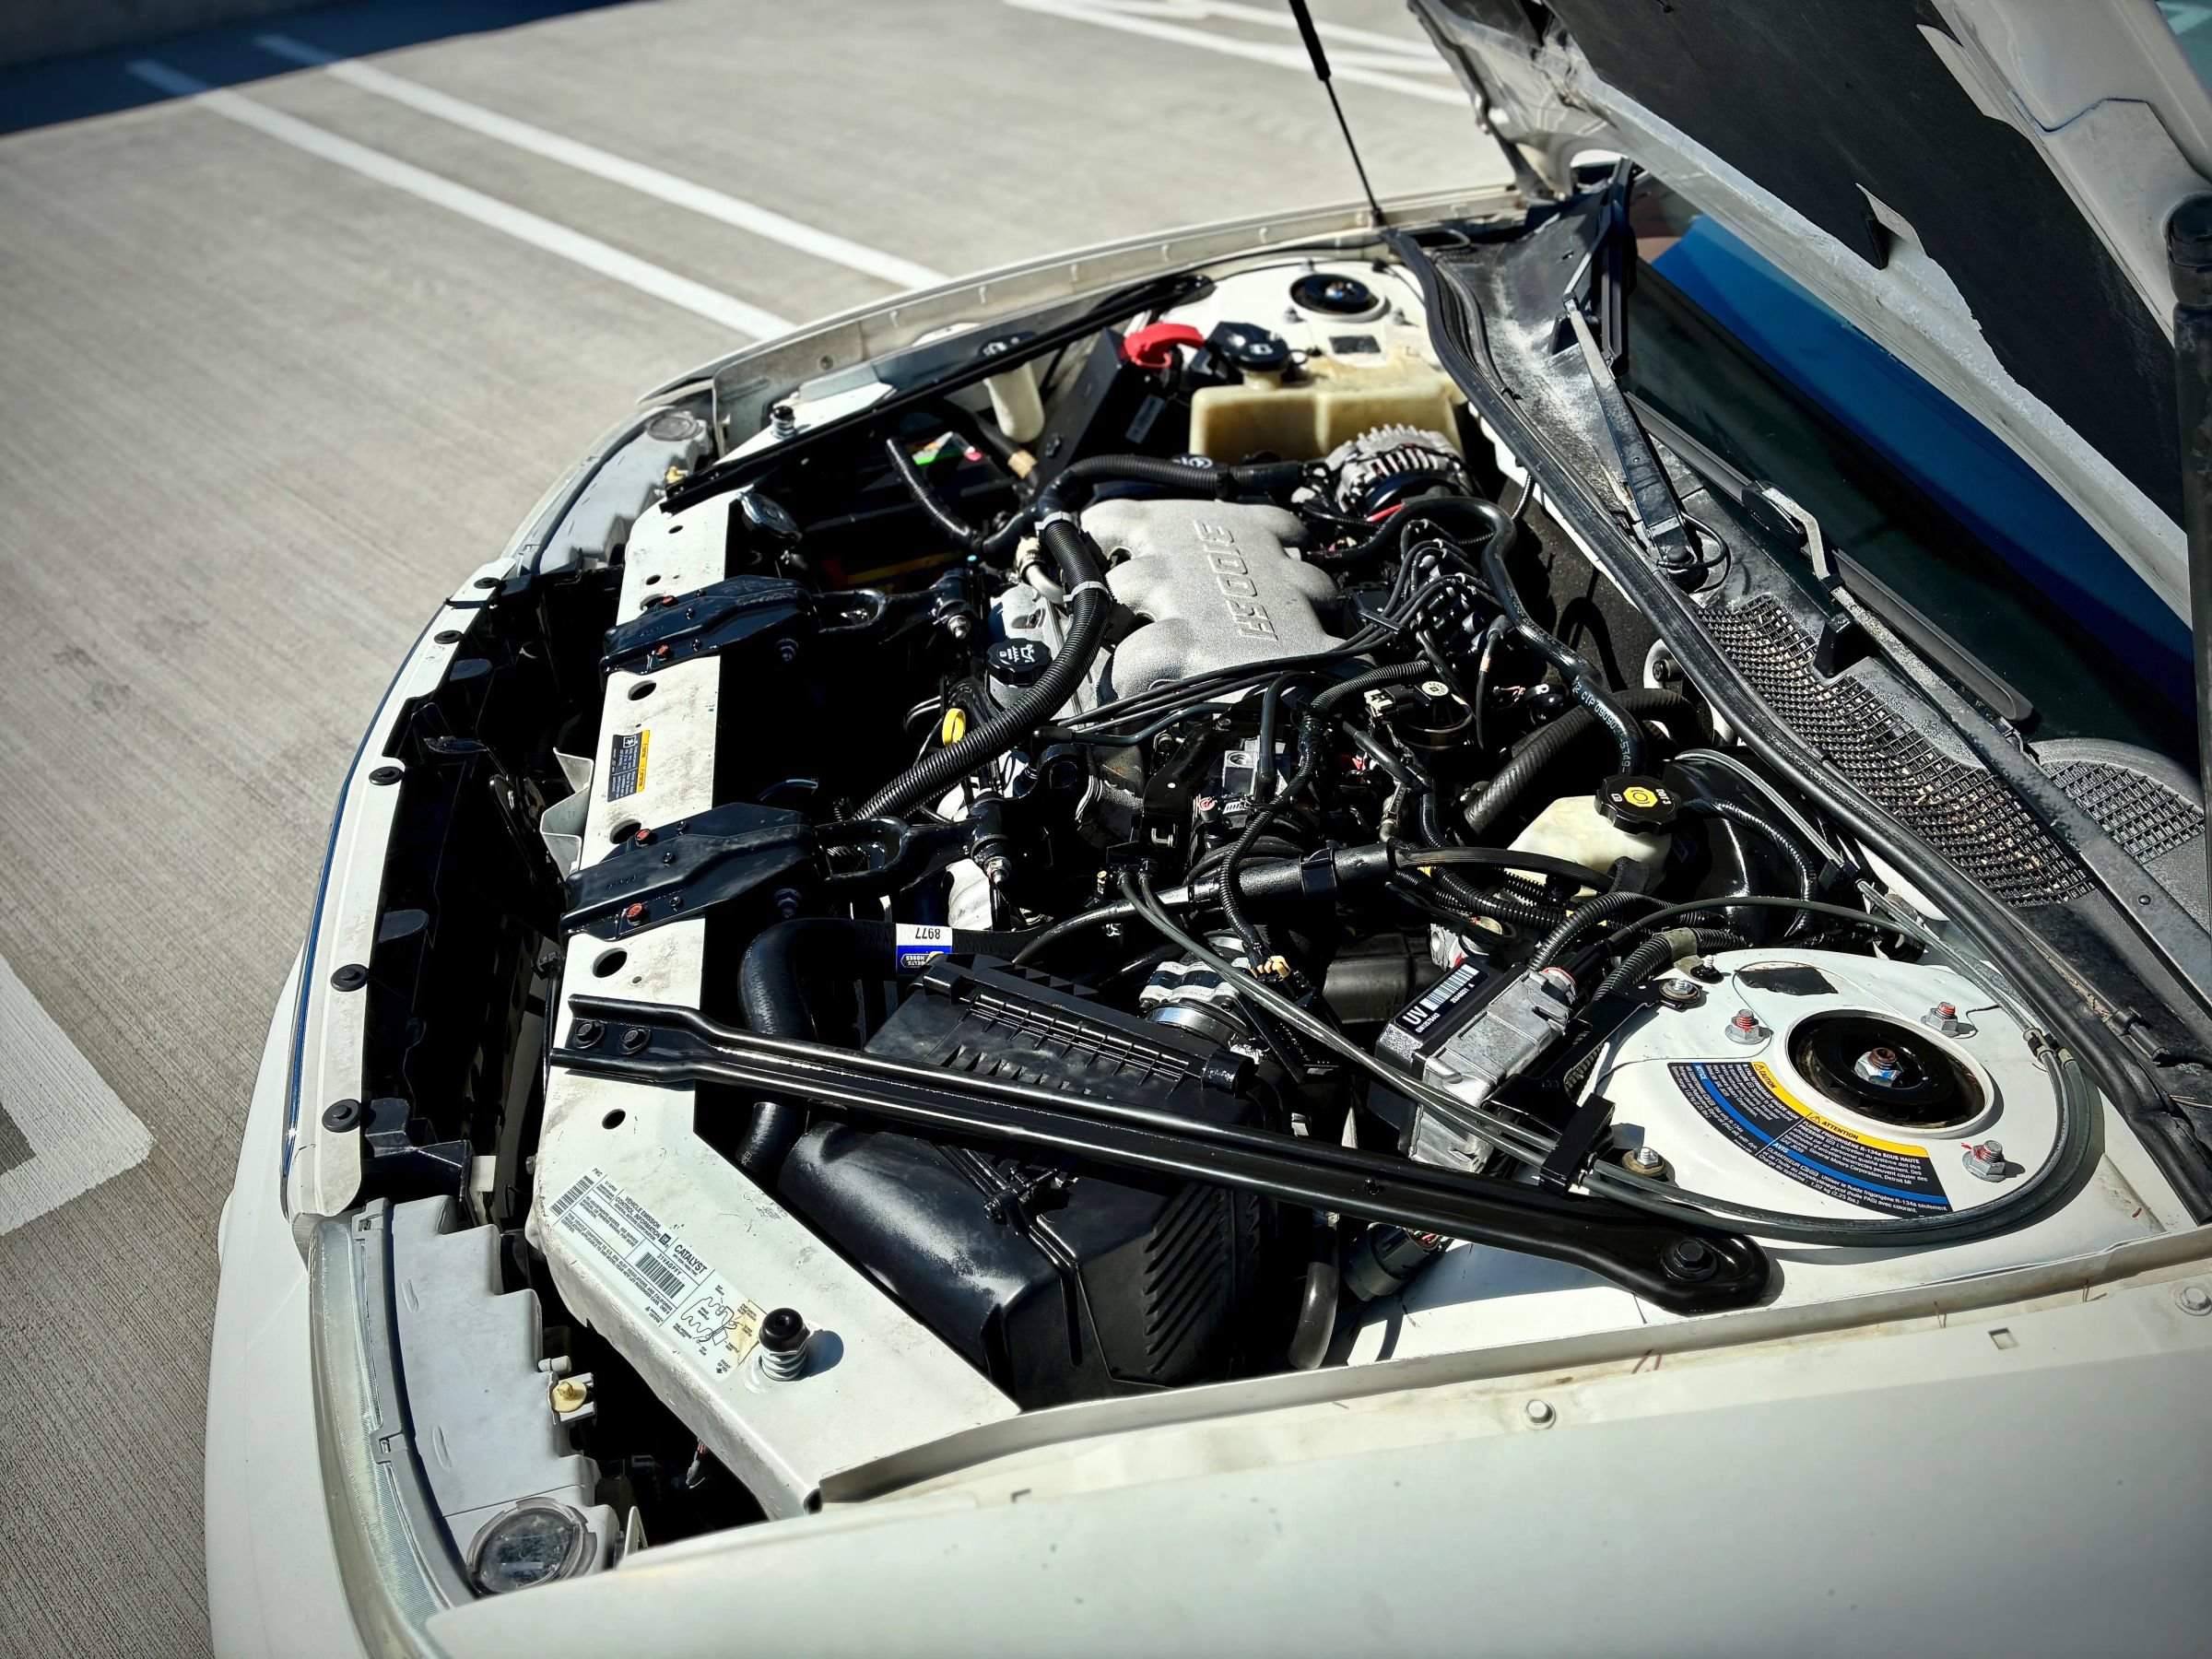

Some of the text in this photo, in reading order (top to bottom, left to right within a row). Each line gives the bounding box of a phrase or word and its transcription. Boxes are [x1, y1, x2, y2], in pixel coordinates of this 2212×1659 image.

[1193, 519, 1257, 596] 3100
[1655, 788, 1670, 800] DOT
[915, 927, 941, 940] 8977
[1403, 1006, 1428, 1025] UV
[1693, 1064, 1708, 1080] NOTICE
[1759, 1069, 1777, 1088] CAUTION
[1750, 1087, 1766, 1101] System
[1772, 1107, 1793, 1122] serviced
[1752, 1105, 1773, 1121] personal
[1771, 1098, 1787, 1112] UNDER
[1785, 1110, 1799, 1120] HIGH
[1737, 1134, 1749, 1143] with
[1796, 1124, 1825, 1140] PRESSION
[1802, 1120, 1822, 1132] FLUIDE
[1860, 1146, 1881, 1156] R-134a
[1882, 1152, 1899, 1160] SOUS
[1820, 1121, 1859, 1140] ATTENTION
[1771, 1141, 1790, 1153] AVIS
[1779, 1136, 1791, 1145] SAE
[1808, 1147, 1830, 1159] General
[1830, 1157, 1849, 1168] Motors
[1884, 1174, 1902, 1182] Detroit
[1766, 1147, 1800, 1168] CLIMATISEUR
[1847, 1184, 1863, 1194] fluide
[1895, 1198, 1917, 1206] R-134a
[614, 1196, 635, 1215] CONTROL
[632, 1212, 662, 1238] INFORMATION
[623, 1195, 661, 1229] VEHICLE EMISSION
[672, 1242, 708, 1275] CATALYST
[646, 1286, 655, 1294] AND
